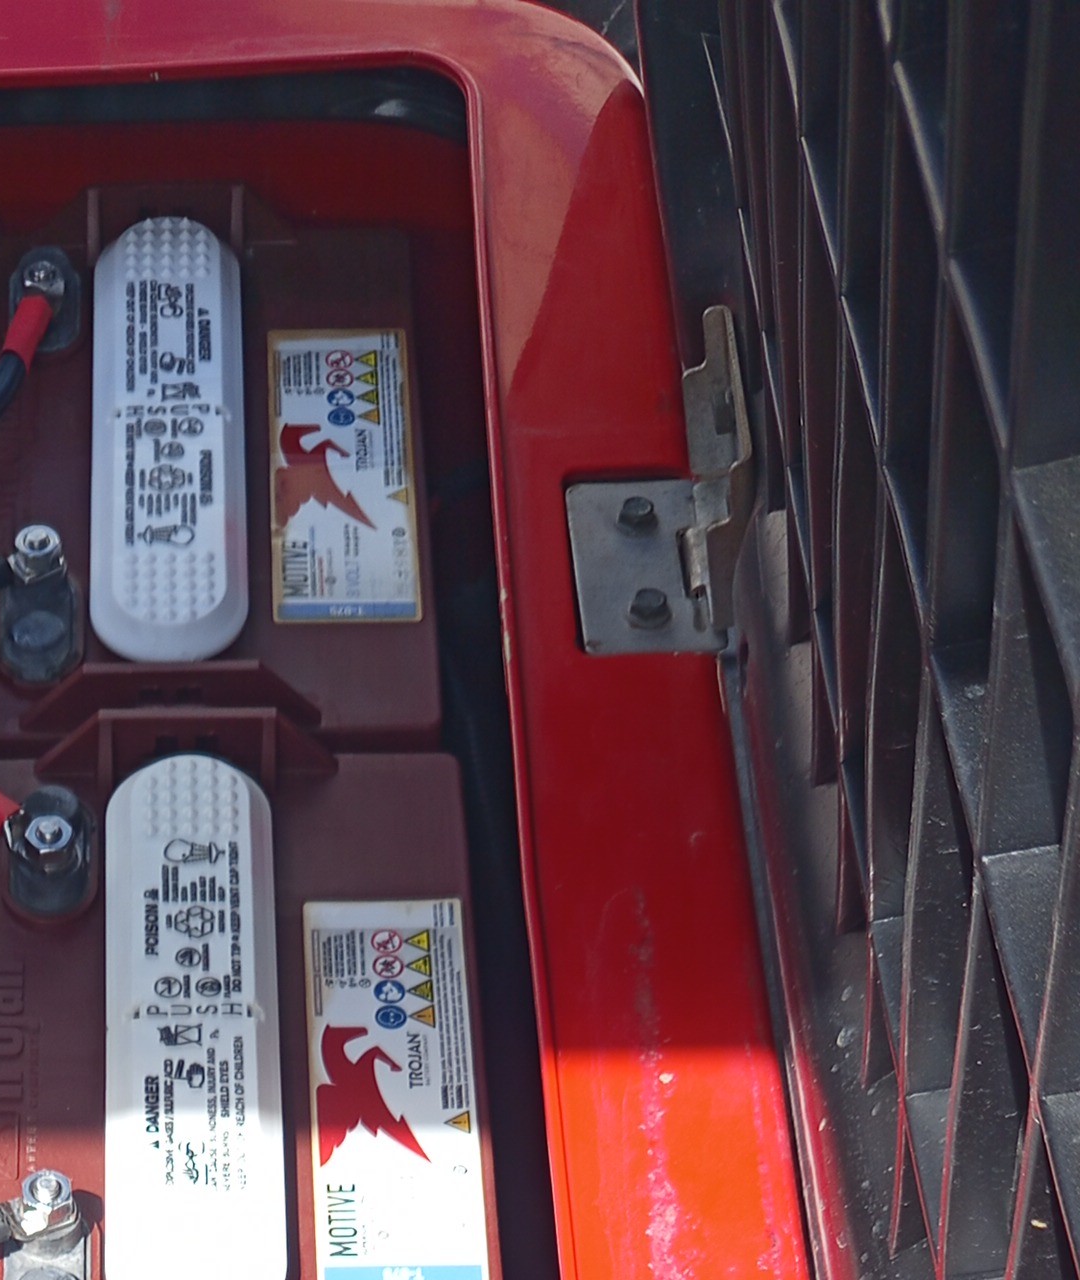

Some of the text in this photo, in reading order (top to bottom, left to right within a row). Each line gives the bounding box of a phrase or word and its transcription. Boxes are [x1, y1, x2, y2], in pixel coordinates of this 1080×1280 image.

[283, 541, 309, 597] MOTIVE
[145, 904, 158, 955] POISON
[220, 1060, 228, 1084] EYES
[407, 1033, 424, 1089] TROJAN
[145, 1076, 160, 1132] DANGER
[327, 1183, 358, 1256] MOTIVE
